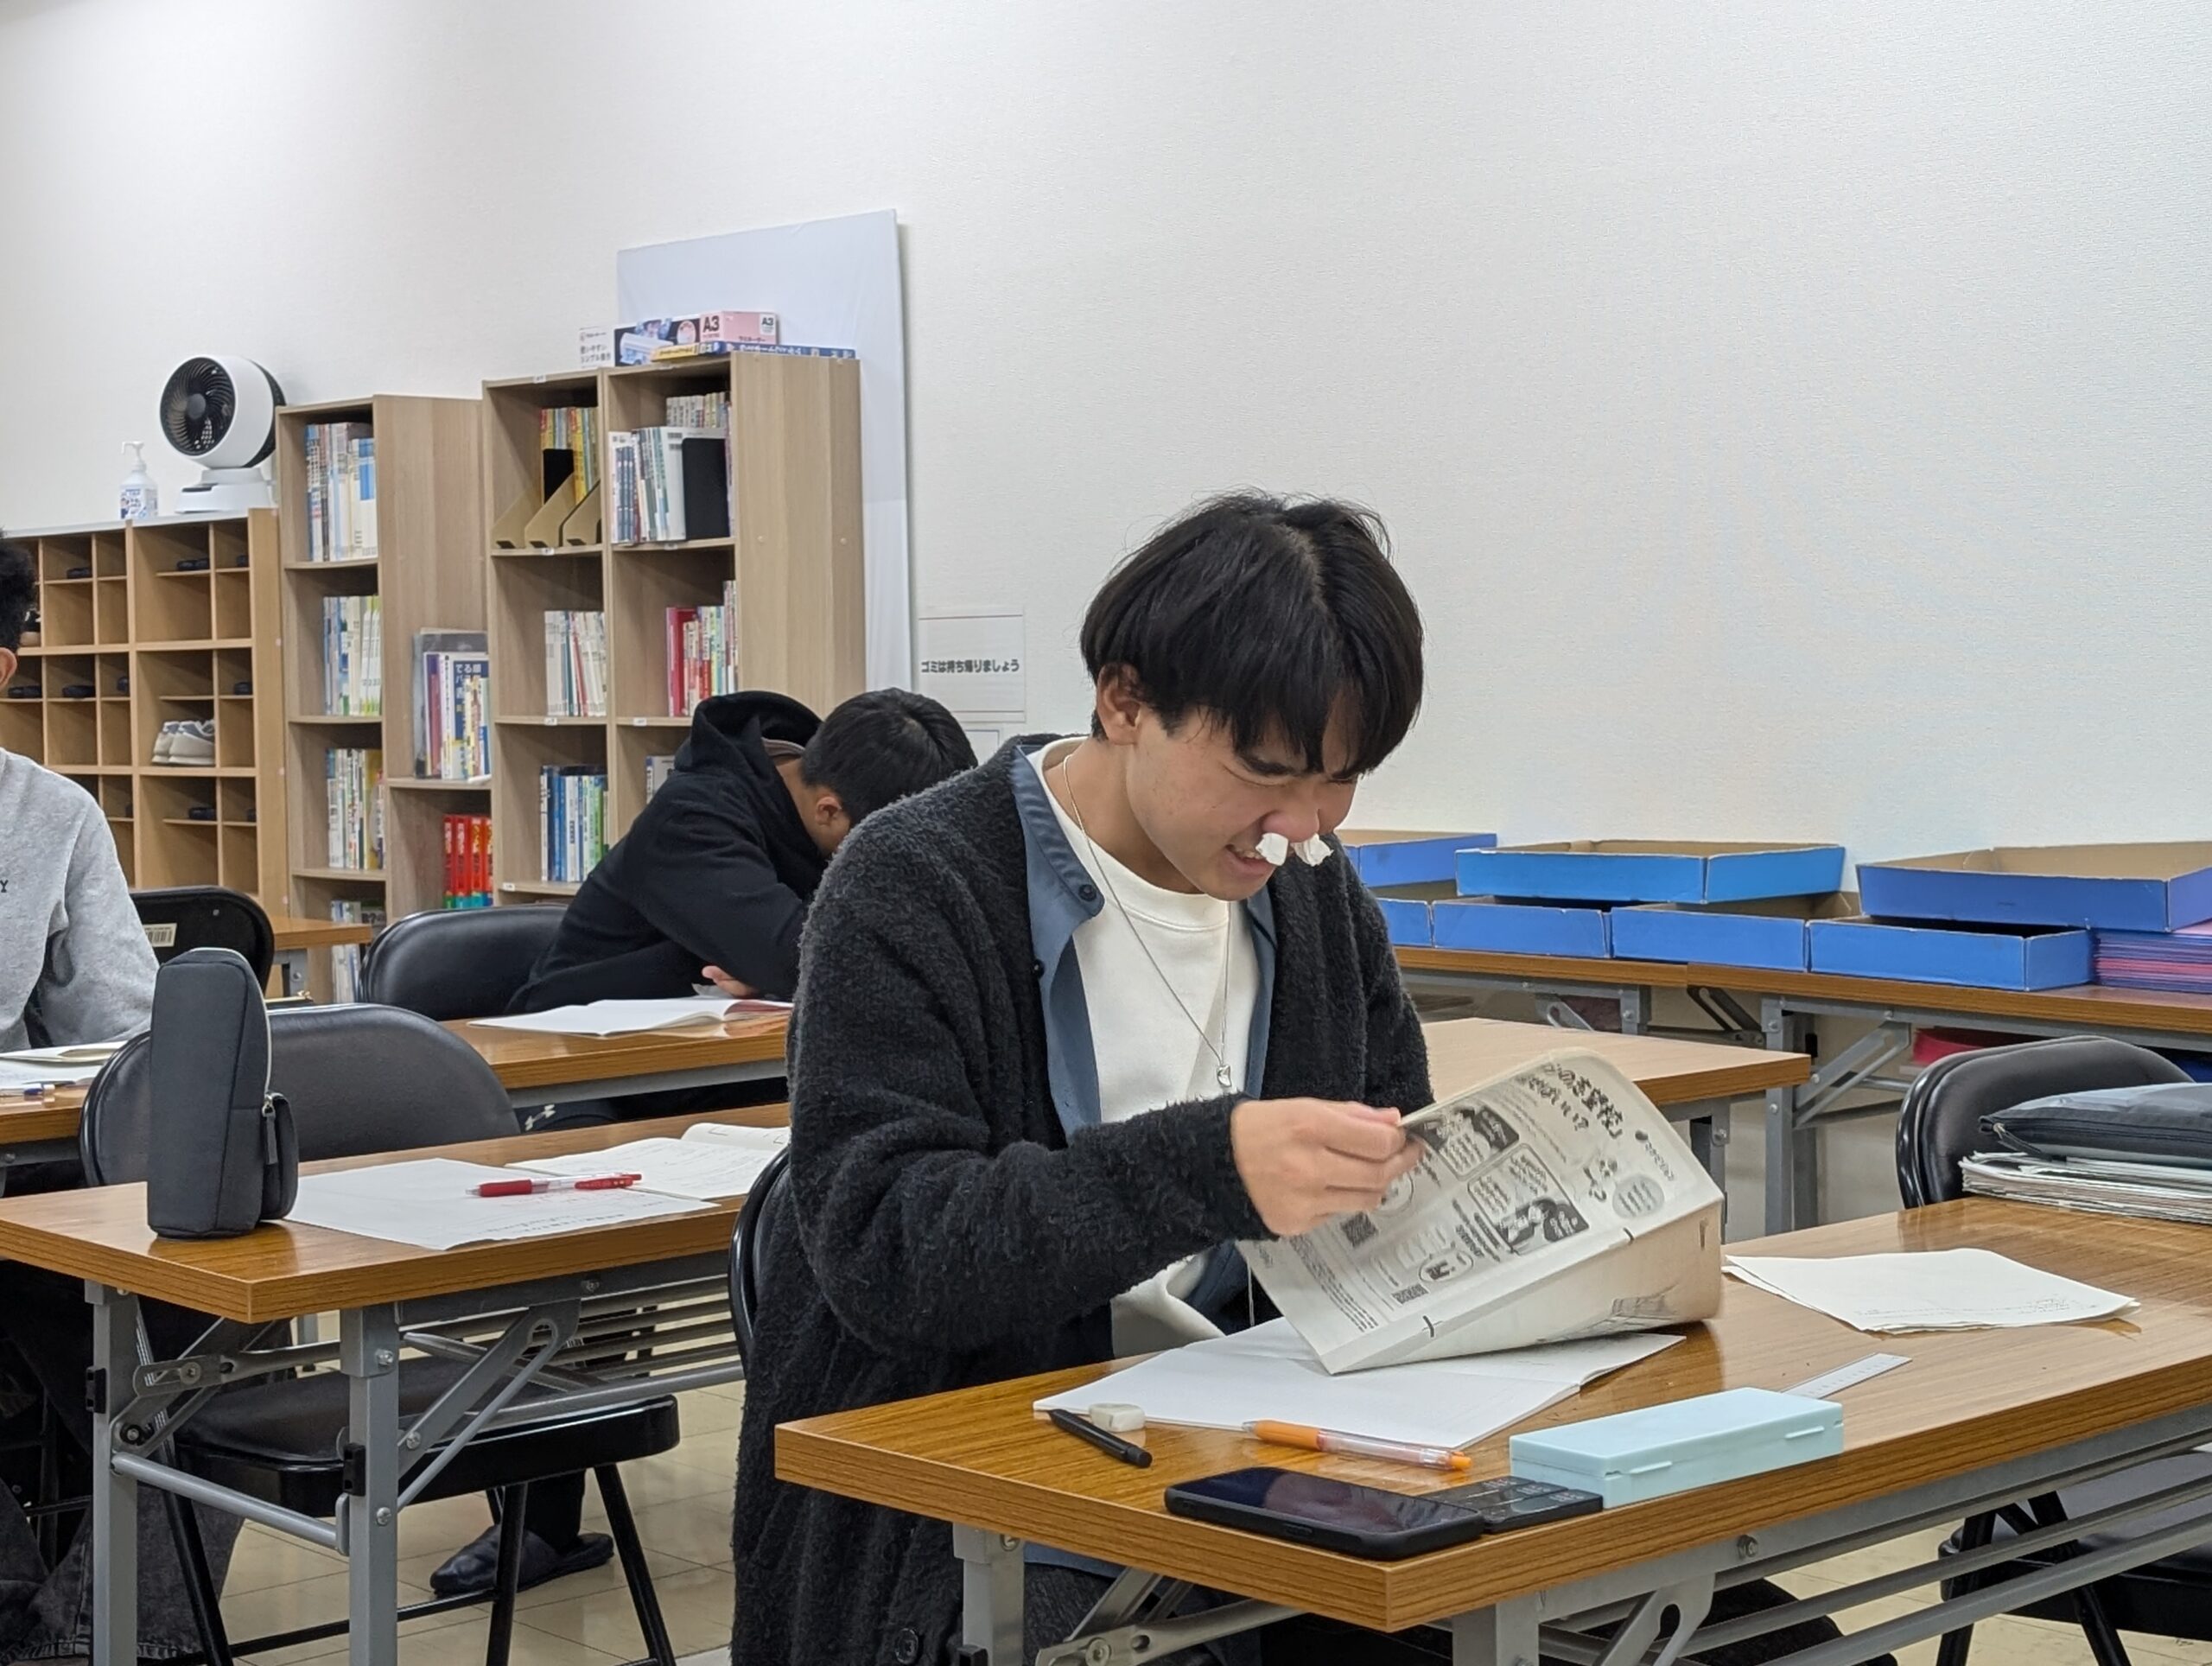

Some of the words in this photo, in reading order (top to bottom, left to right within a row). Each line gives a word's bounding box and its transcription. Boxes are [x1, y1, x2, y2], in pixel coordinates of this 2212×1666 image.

[702, 315, 720, 333] A3
[761, 317, 774, 326] A3
[921, 658, 1020, 673] ゴミは持ち帰りましょう
[0, 880, 9, 893] Y
